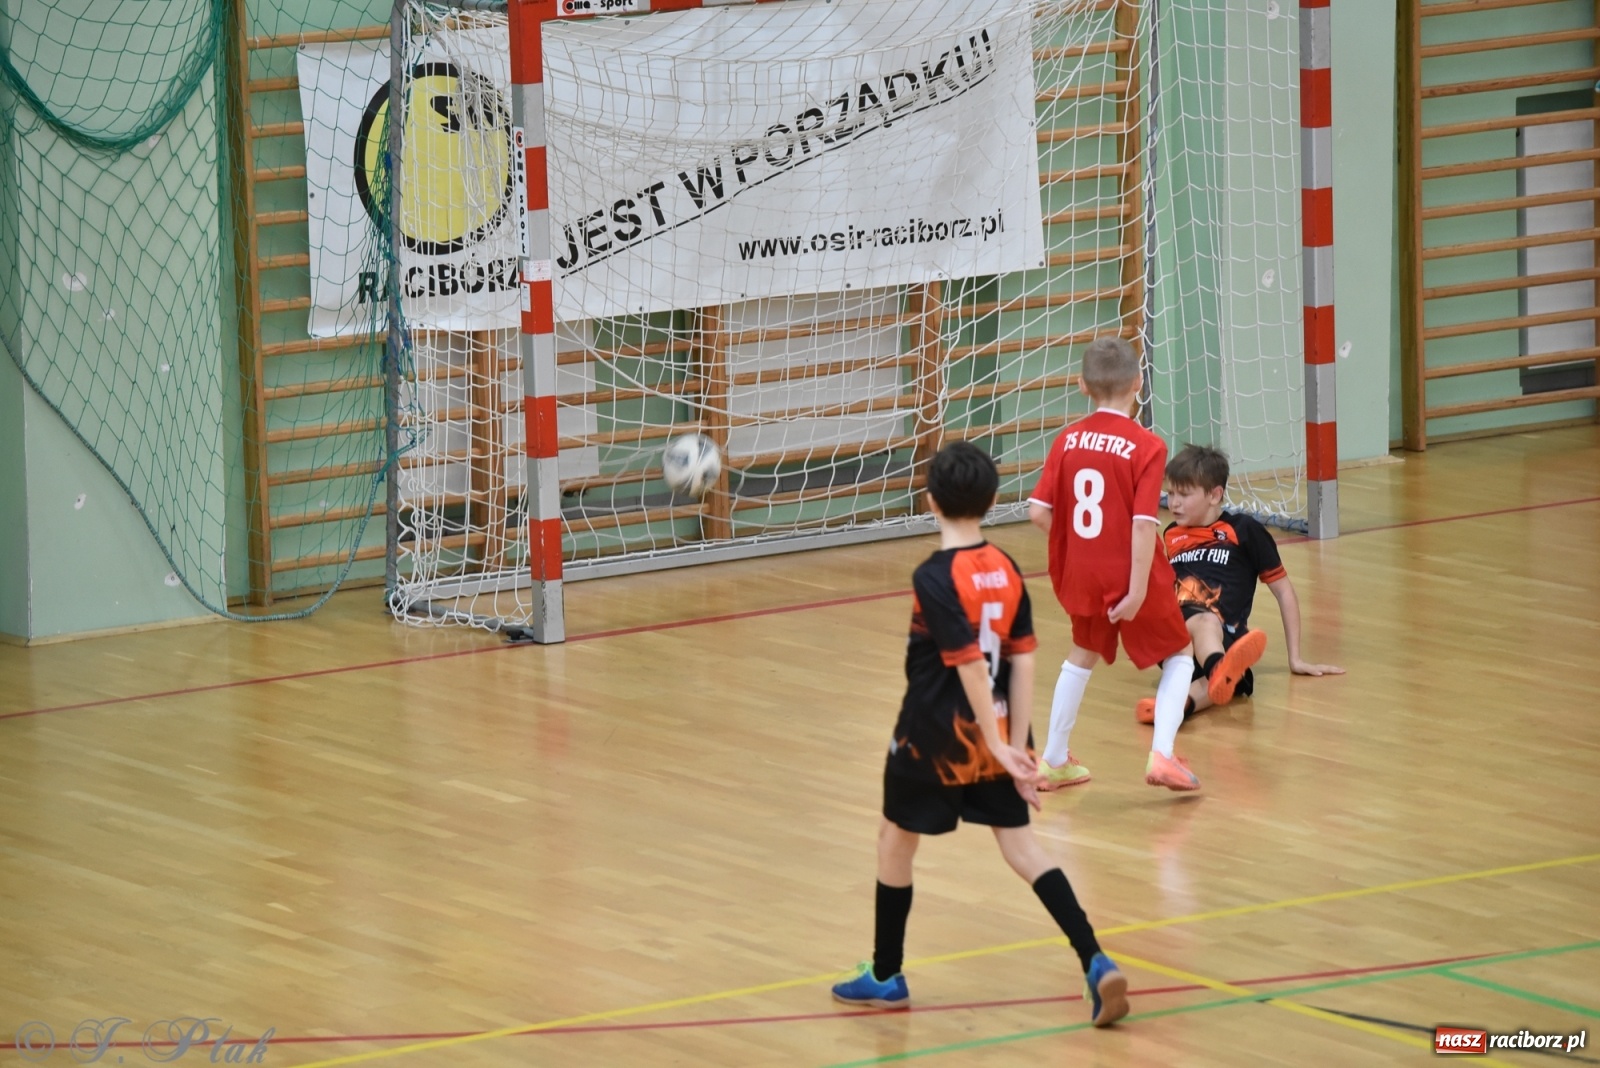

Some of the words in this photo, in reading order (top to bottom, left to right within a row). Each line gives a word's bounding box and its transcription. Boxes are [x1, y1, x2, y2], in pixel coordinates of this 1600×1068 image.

[556, 181, 666, 269] JEST
[678, 155, 724, 209] W
[738, 208, 1004, 261] www.osir-raciborz.pl
[1078, 431, 1137, 460] KIETRZ
[1073, 468, 1105, 539] 8
[1207, 548, 1230, 565] FUH
